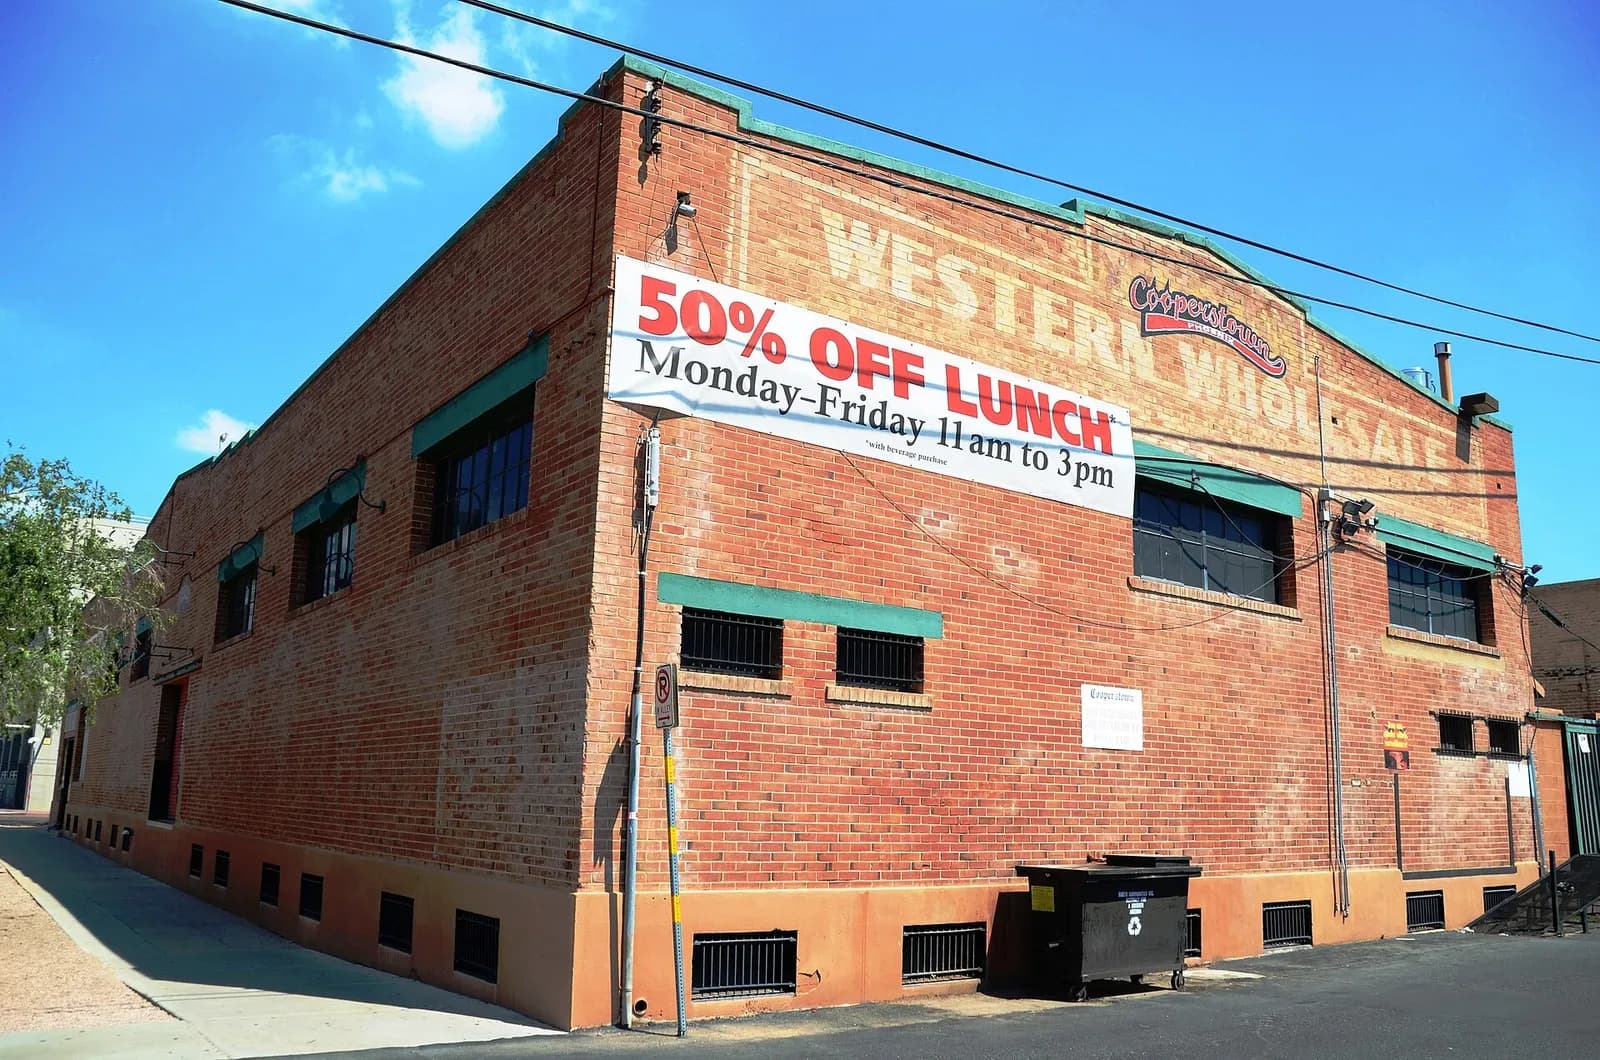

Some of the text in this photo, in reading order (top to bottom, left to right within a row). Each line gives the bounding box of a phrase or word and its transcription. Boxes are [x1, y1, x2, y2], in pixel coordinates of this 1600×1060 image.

[638, 274, 787, 365] 50%
[809, 326, 926, 400] OFF
[822, 207, 1449, 483] WESTERN WHOLESALE
[887, 444, 917, 459] beverage
[918, 453, 948, 466] purchase
[1021, 441, 1049, 471] to
[1057, 448, 1114, 489] 3pm
